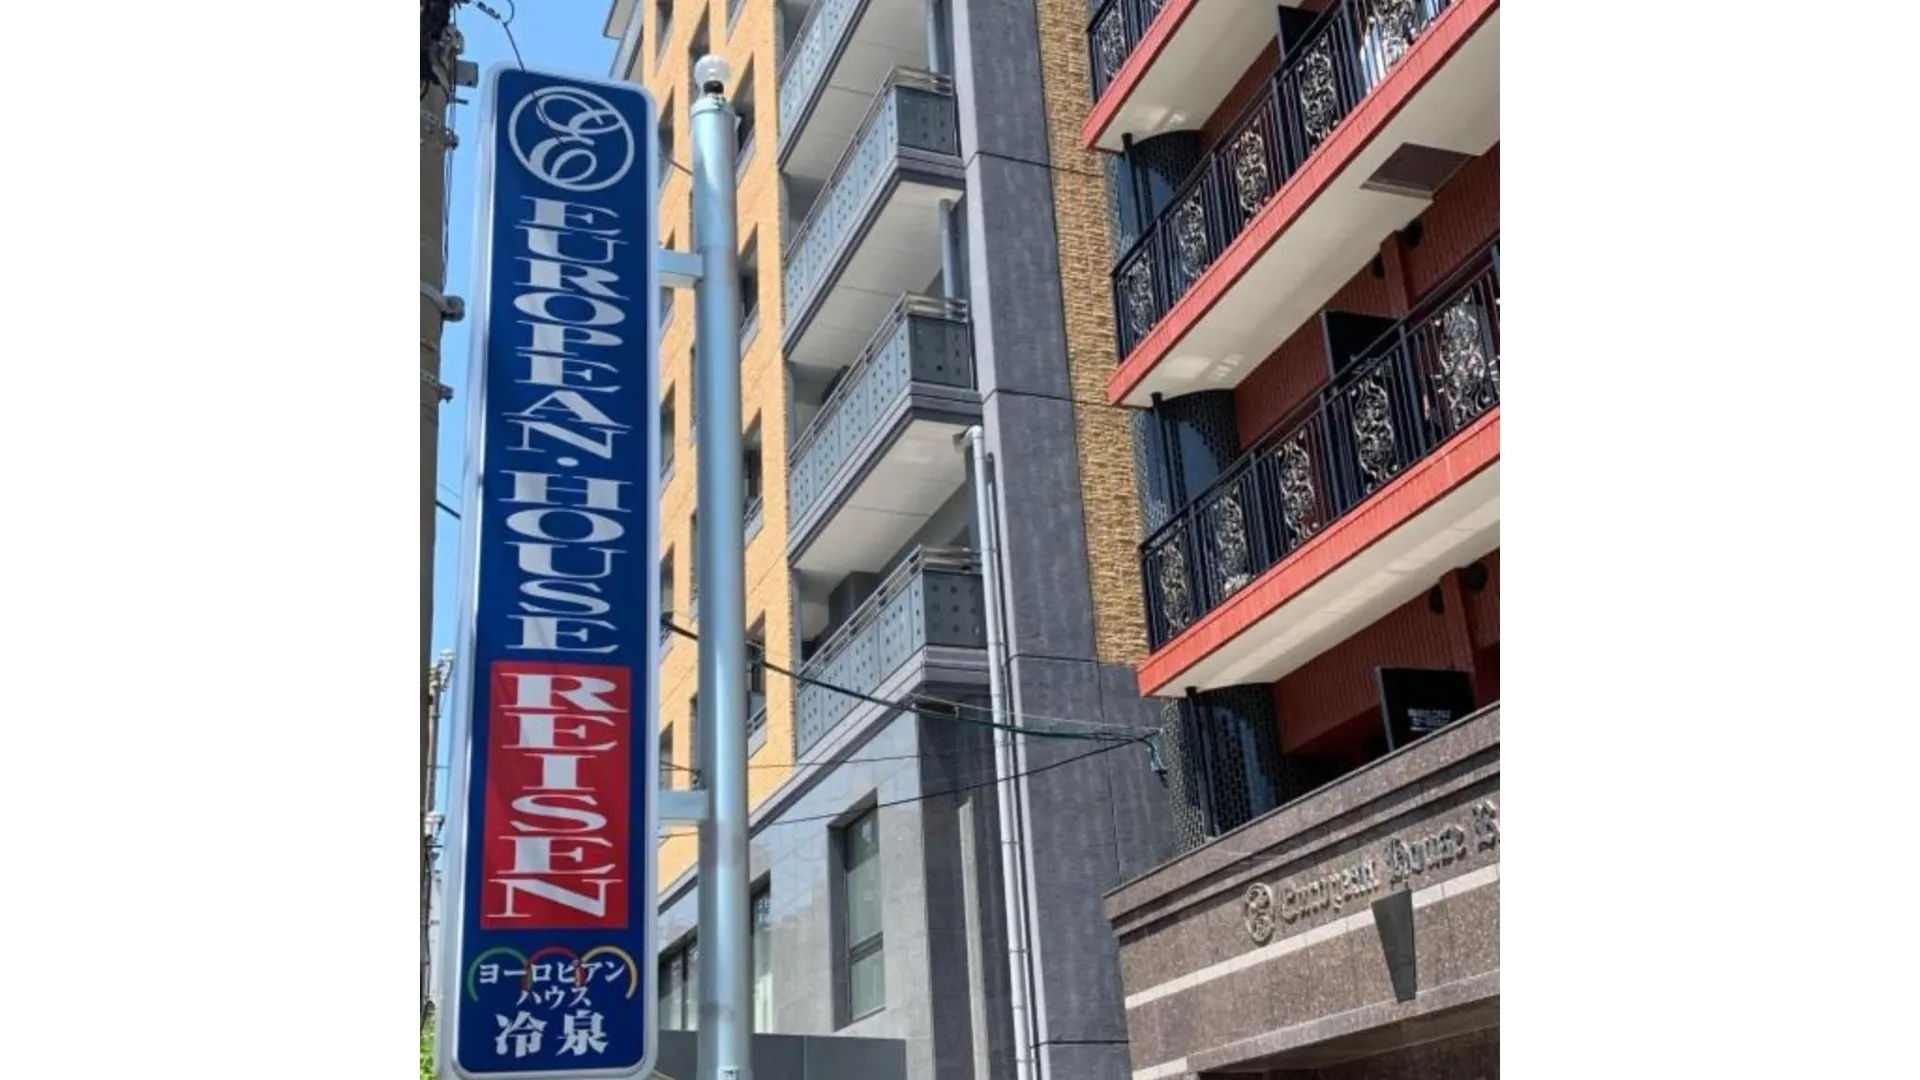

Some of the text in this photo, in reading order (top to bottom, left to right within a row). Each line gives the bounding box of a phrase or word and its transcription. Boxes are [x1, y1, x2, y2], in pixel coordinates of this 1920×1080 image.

[486, 672, 628, 919] REISEN
[478, 959, 627, 988] ヨーロピアン
[515, 985, 592, 1009] ハウス
[494, 1008, 609, 1059] 冷泉
